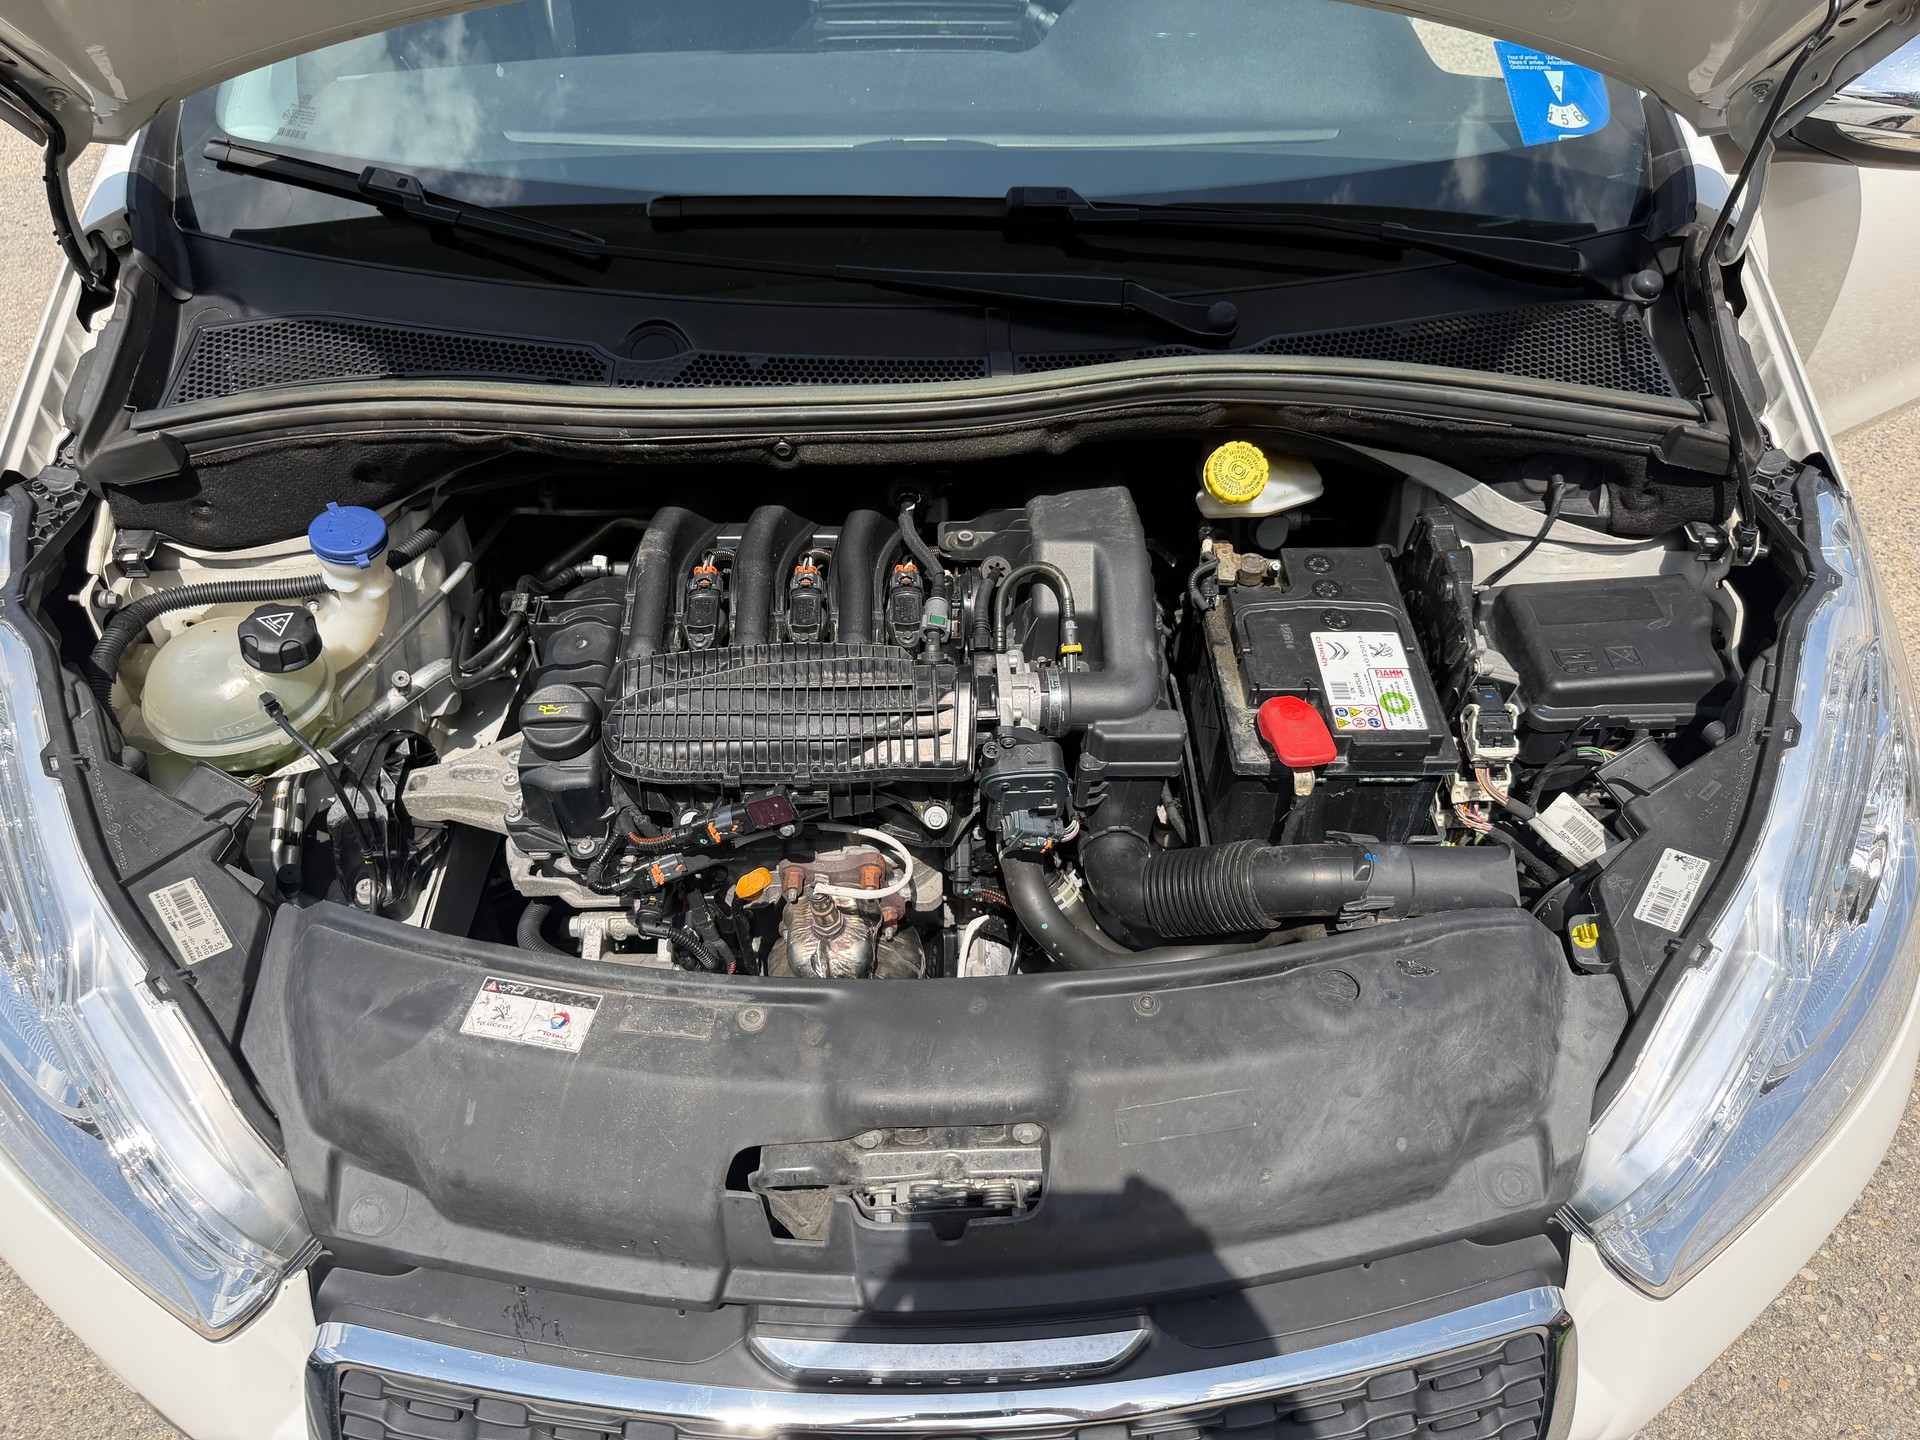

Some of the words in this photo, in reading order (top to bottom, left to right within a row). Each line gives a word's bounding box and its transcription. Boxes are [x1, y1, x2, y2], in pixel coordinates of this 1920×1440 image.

[1561, 114, 1569, 125] 5
[1573, 111, 1583, 121] 6
[1357, 636, 1370, 667] PEUGEOT
[1557, 829, 1586, 854] 56PL21013
[477, 1020, 513, 1030] PEUGEOT
[543, 1030, 565, 1040] TOTAL
